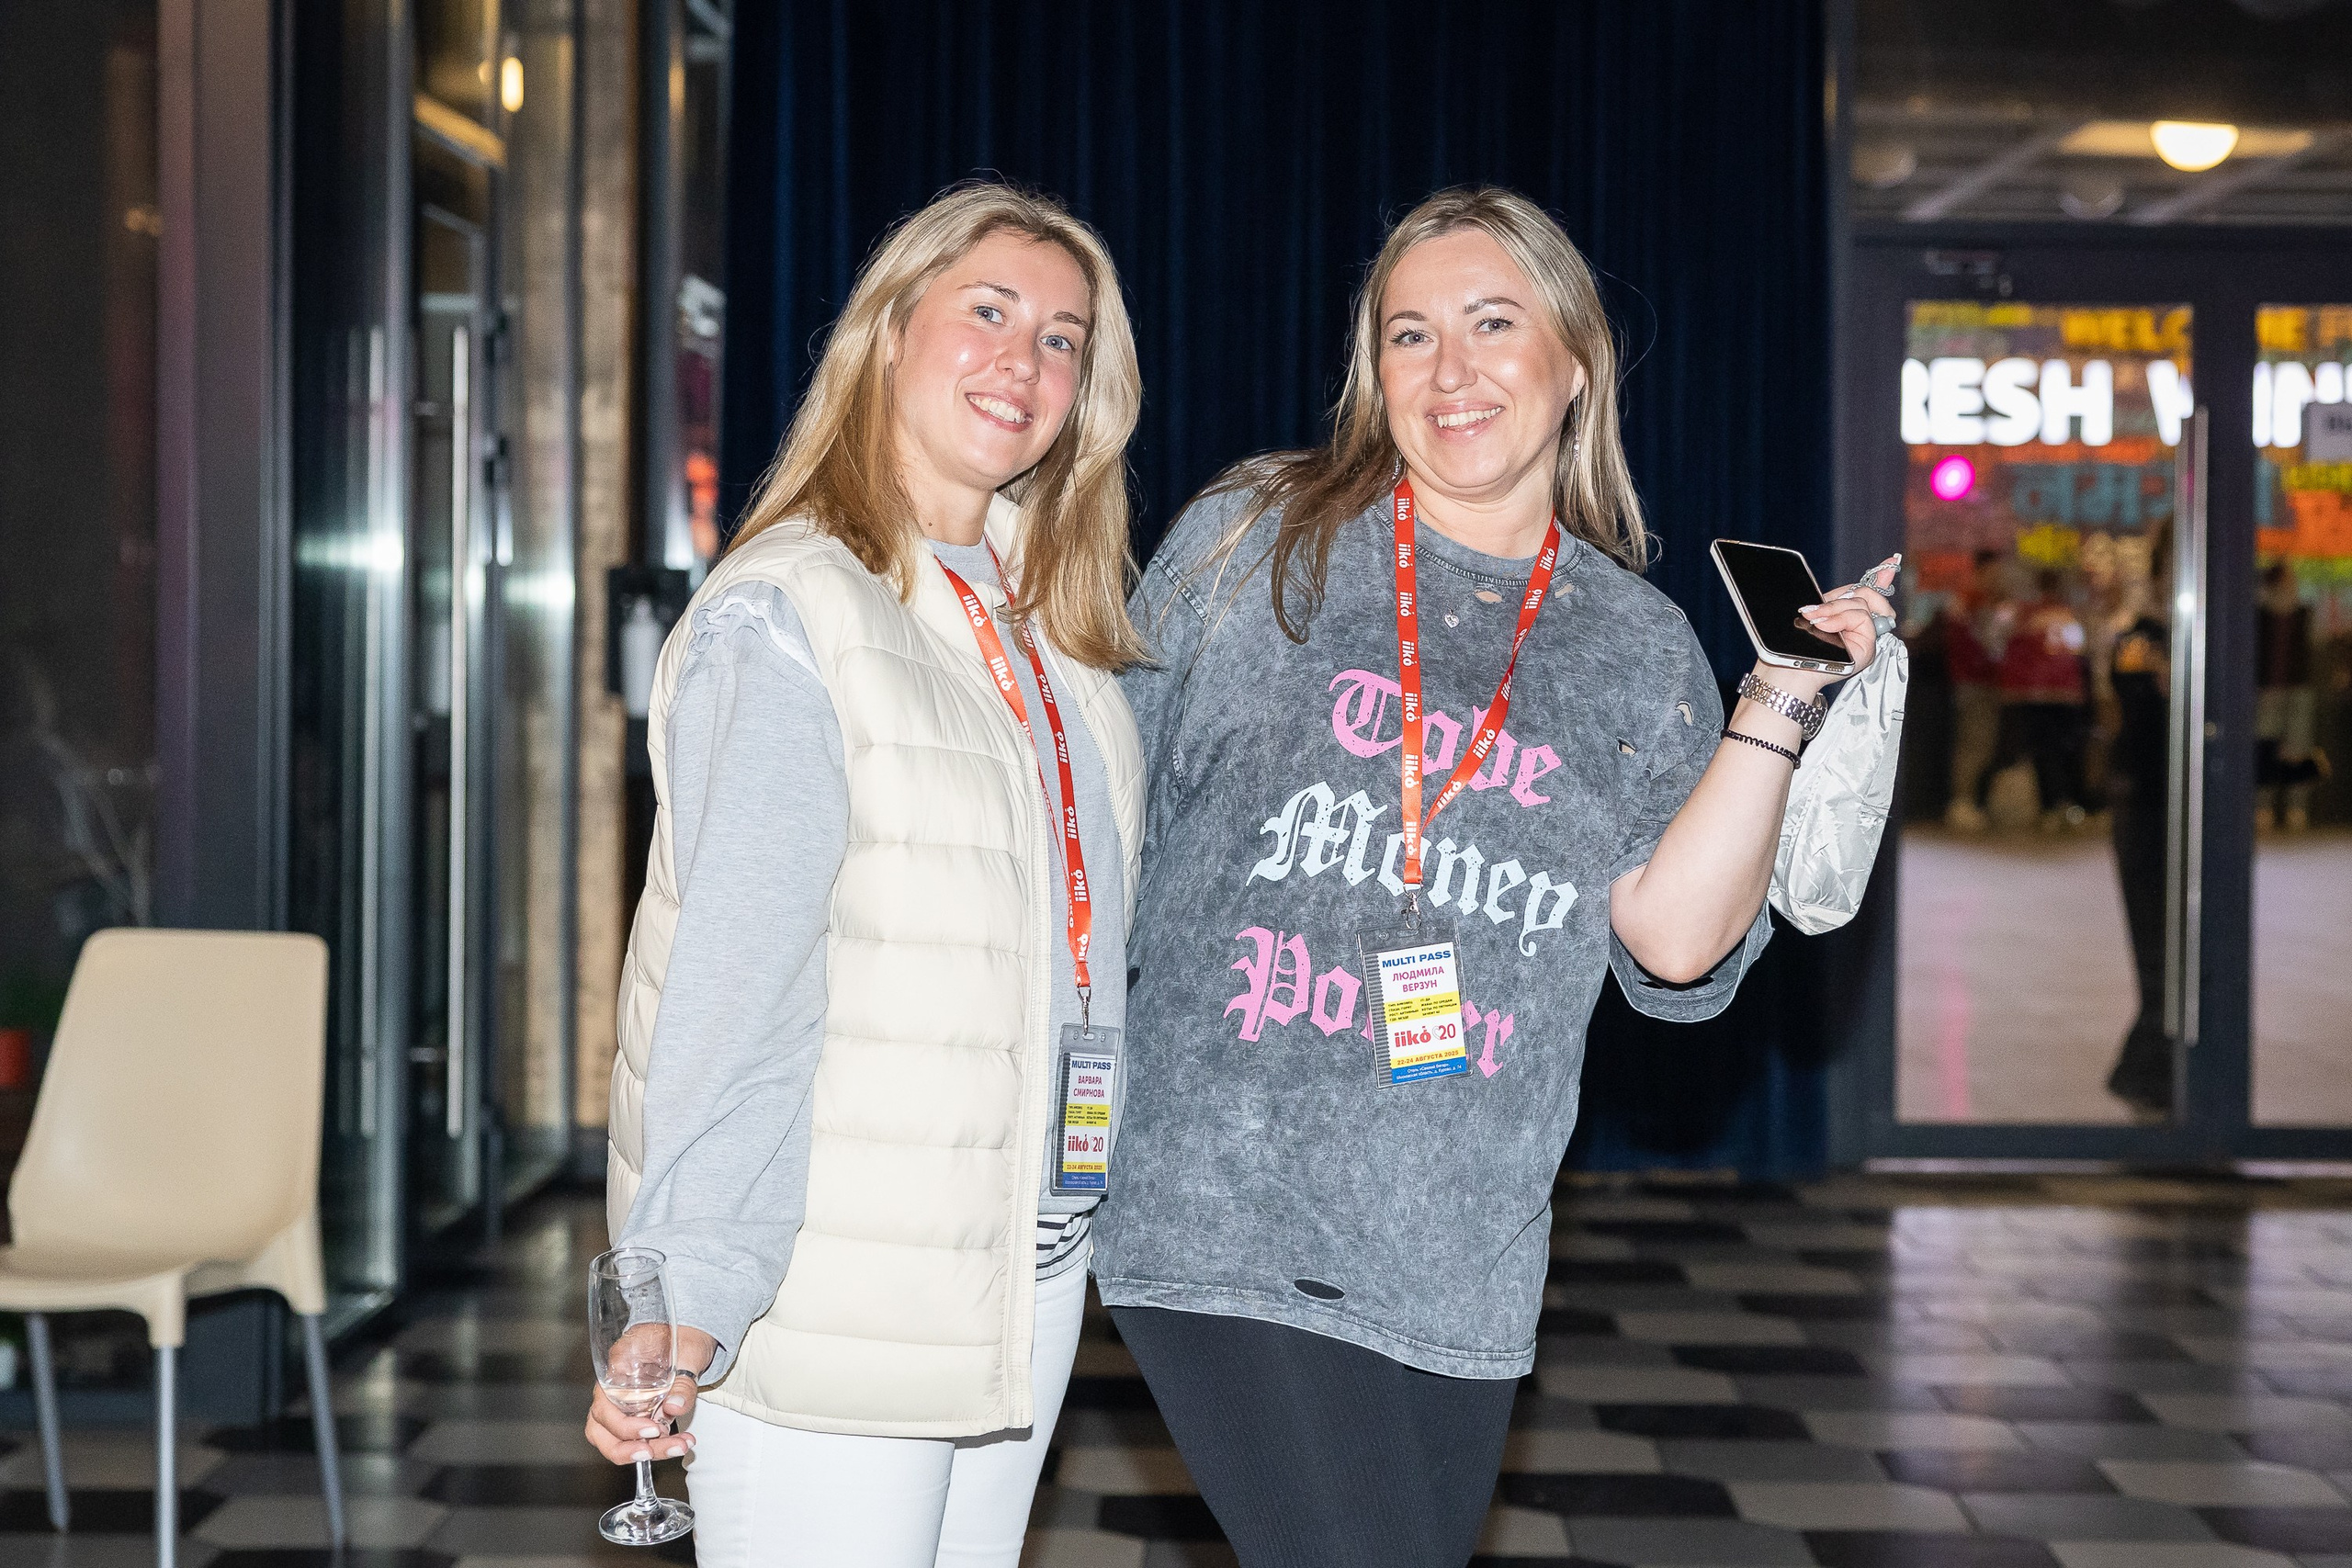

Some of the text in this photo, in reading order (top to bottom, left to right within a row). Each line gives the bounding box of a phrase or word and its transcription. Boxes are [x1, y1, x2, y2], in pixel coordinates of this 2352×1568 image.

[1382, 950, 1451, 967] MULTI PASS
[1393, 966, 1444, 981] ЛЮДМИЛА
[1402, 979, 1438, 992] ВЕРЗУН
[1223, 926, 1514, 1078] Por
[1438, 1023, 1456, 1040] 20
[1071, 1060, 1112, 1070] MULTI PASS
[1396, 1057, 1414, 1066] 22-24
[1415, 1053, 1443, 1062] АВГУСТА
[1078, 1075, 1102, 1085] ВАРВАРА
[1073, 1088, 1105, 1098] СМИРНОВА
[1092, 1136, 1104, 1152] 20
